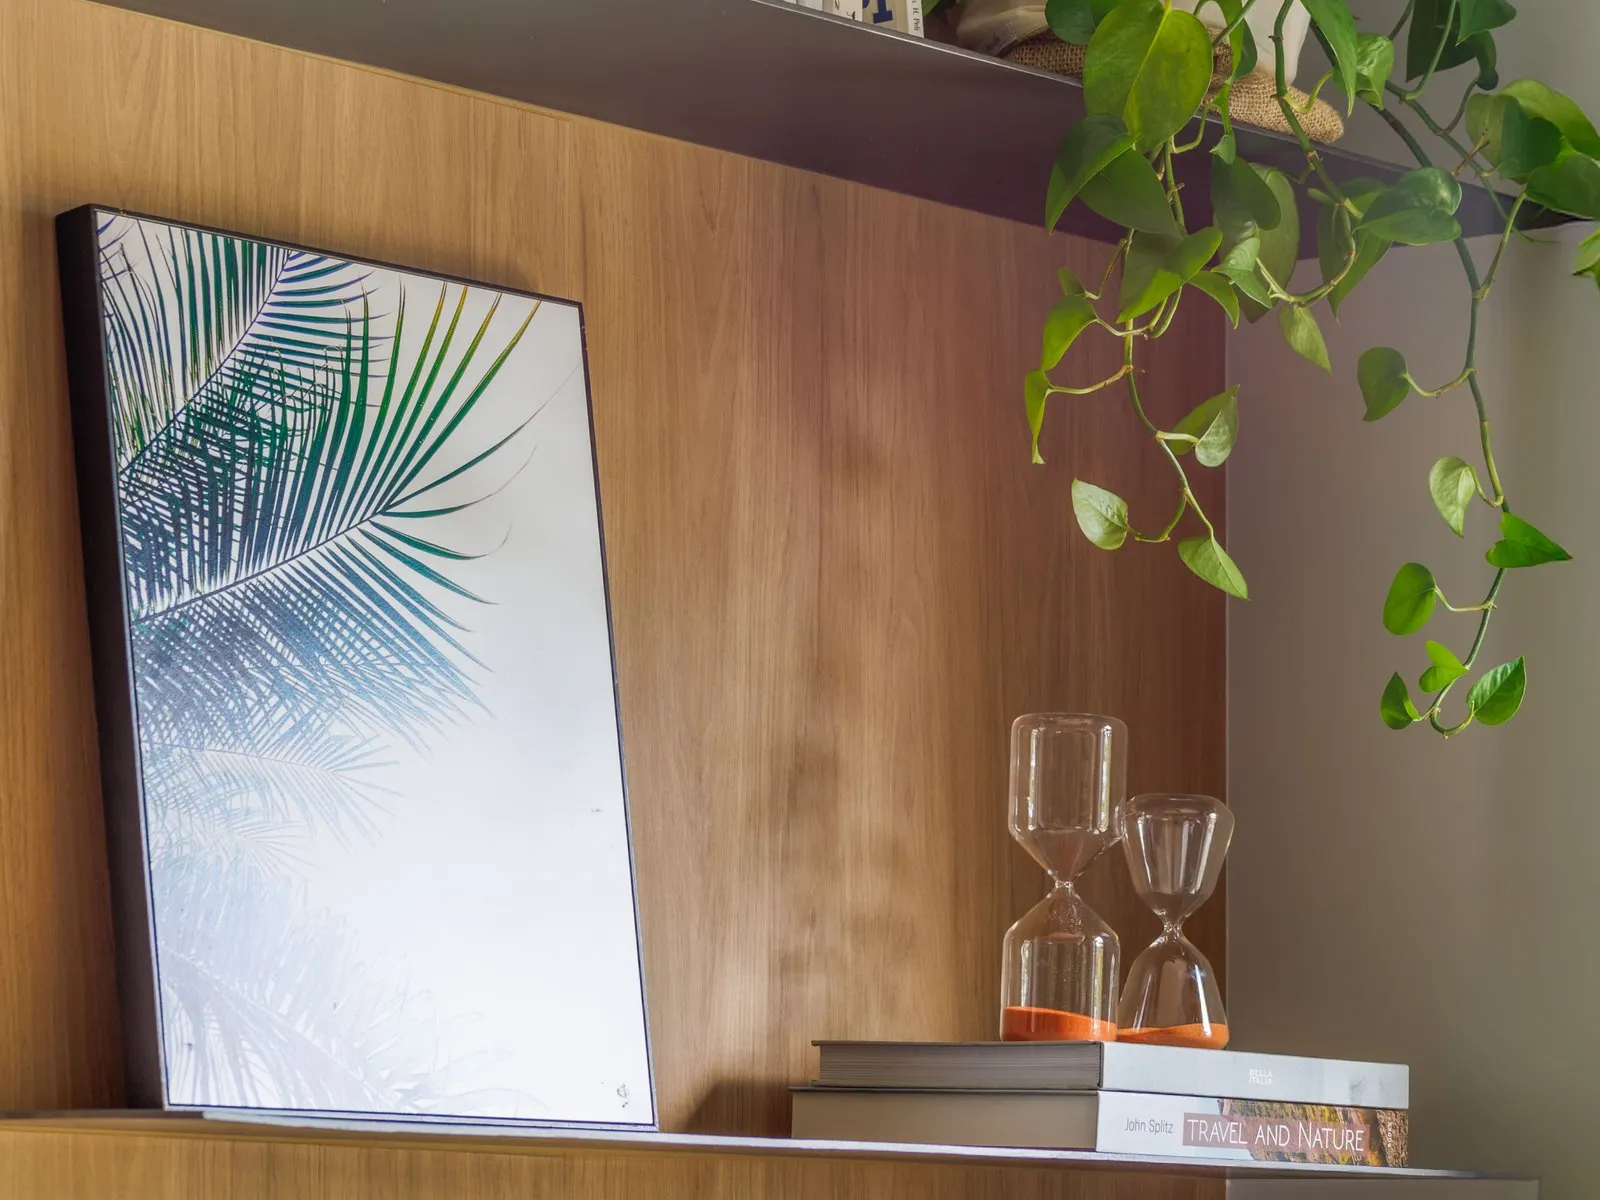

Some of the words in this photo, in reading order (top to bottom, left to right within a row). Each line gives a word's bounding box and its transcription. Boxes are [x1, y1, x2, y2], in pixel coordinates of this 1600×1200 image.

[1249, 1076, 1273, 1085] ITALIA
[1124, 1118, 1146, 1132] John
[1148, 1118, 1174, 1136] Splitz
[1187, 1119, 1248, 1145] TRAVEL
[1254, 1124, 1291, 1147] AND
[1298, 1120, 1365, 1152] NATURE
